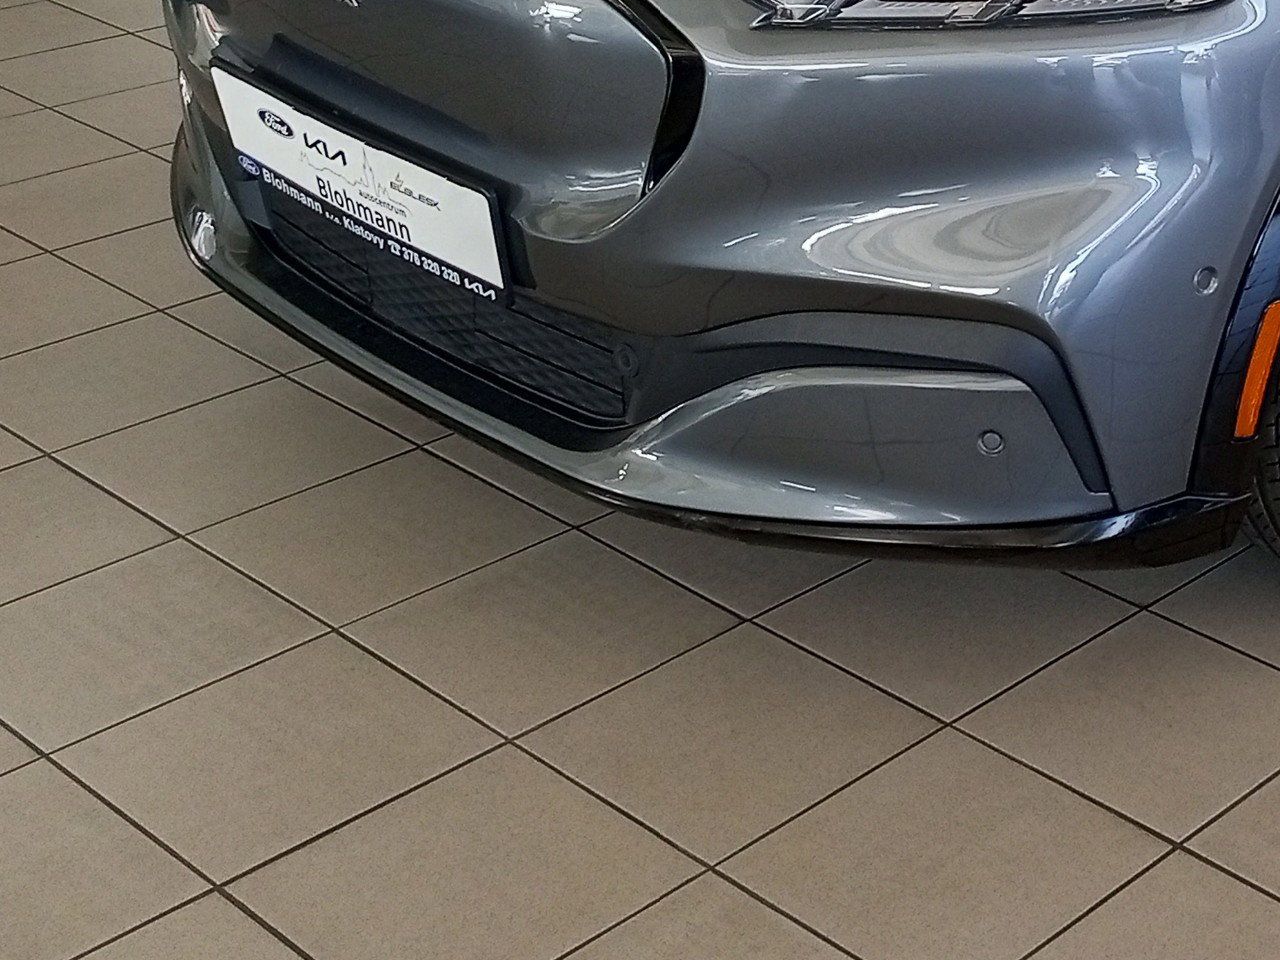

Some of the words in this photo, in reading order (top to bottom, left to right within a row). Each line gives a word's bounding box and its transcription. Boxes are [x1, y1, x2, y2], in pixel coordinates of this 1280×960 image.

[260, 110, 292, 137] Ford
[262, 168, 323, 215] Blohmann
[343, 216, 385, 250] Klatovy
[316, 176, 412, 242] Blohmann
